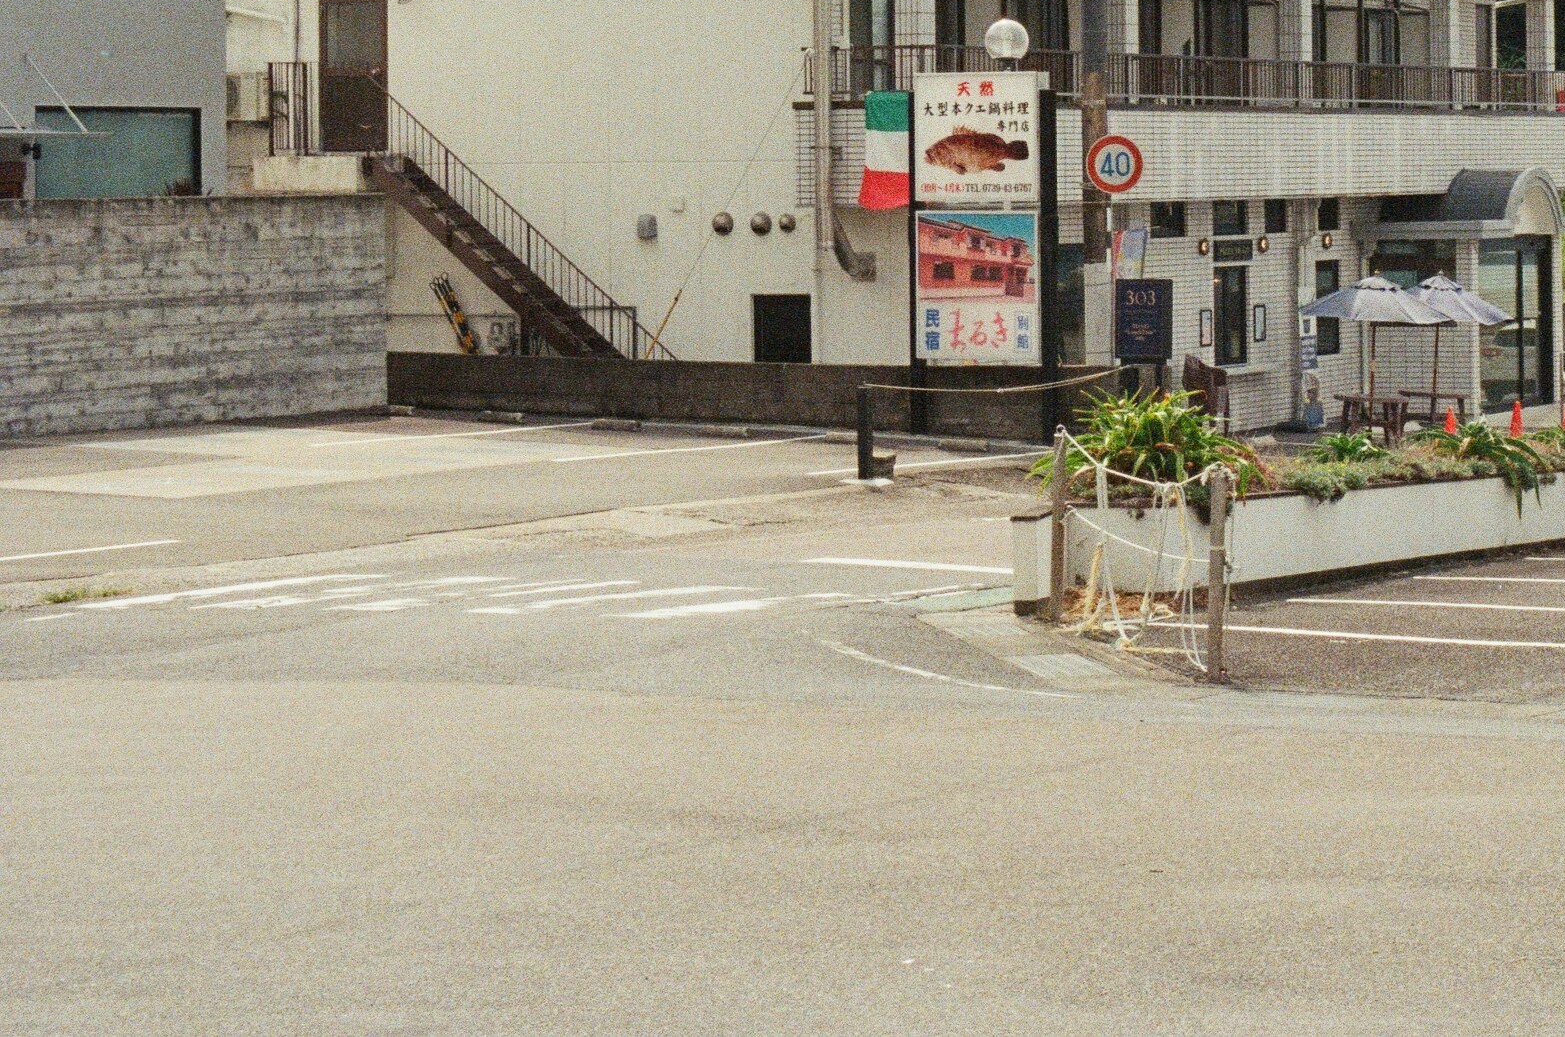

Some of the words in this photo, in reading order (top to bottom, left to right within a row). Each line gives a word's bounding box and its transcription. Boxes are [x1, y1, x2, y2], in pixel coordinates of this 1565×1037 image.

[956, 81, 996, 97] 天然
[923, 101, 1030, 117] 大型本クエ鍋料理
[1100, 151, 1131, 178] 40
[1125, 289, 1157, 307] 303
[925, 308, 940, 351] 民宿
